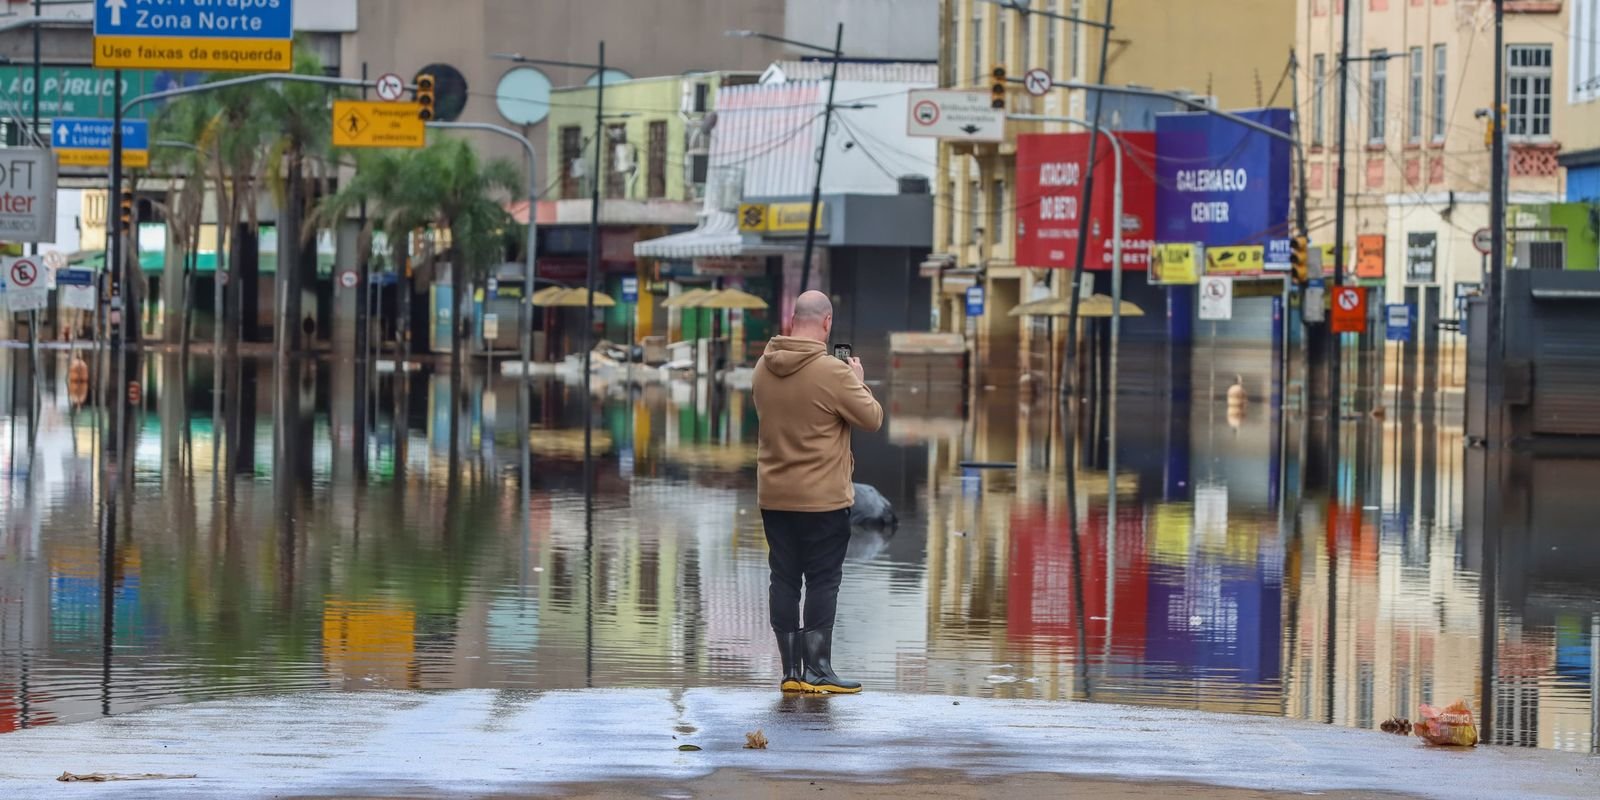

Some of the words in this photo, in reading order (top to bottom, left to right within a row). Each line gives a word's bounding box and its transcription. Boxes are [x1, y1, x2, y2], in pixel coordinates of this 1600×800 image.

[136, 10, 192, 29] Zona
[199, 12, 262, 31] Norte
[102, 45, 132, 59] Use
[138, 46, 183, 60] faixas
[189, 47, 208, 61] da
[212, 48, 282, 63] esquerda
[73, 122, 135, 136] Aeropoto
[1039, 162, 1080, 186] ATACADO
[1040, 196, 1053, 220] DO
[1054, 196, 1077, 219] BETO
[1191, 201, 1229, 223] CENTER
